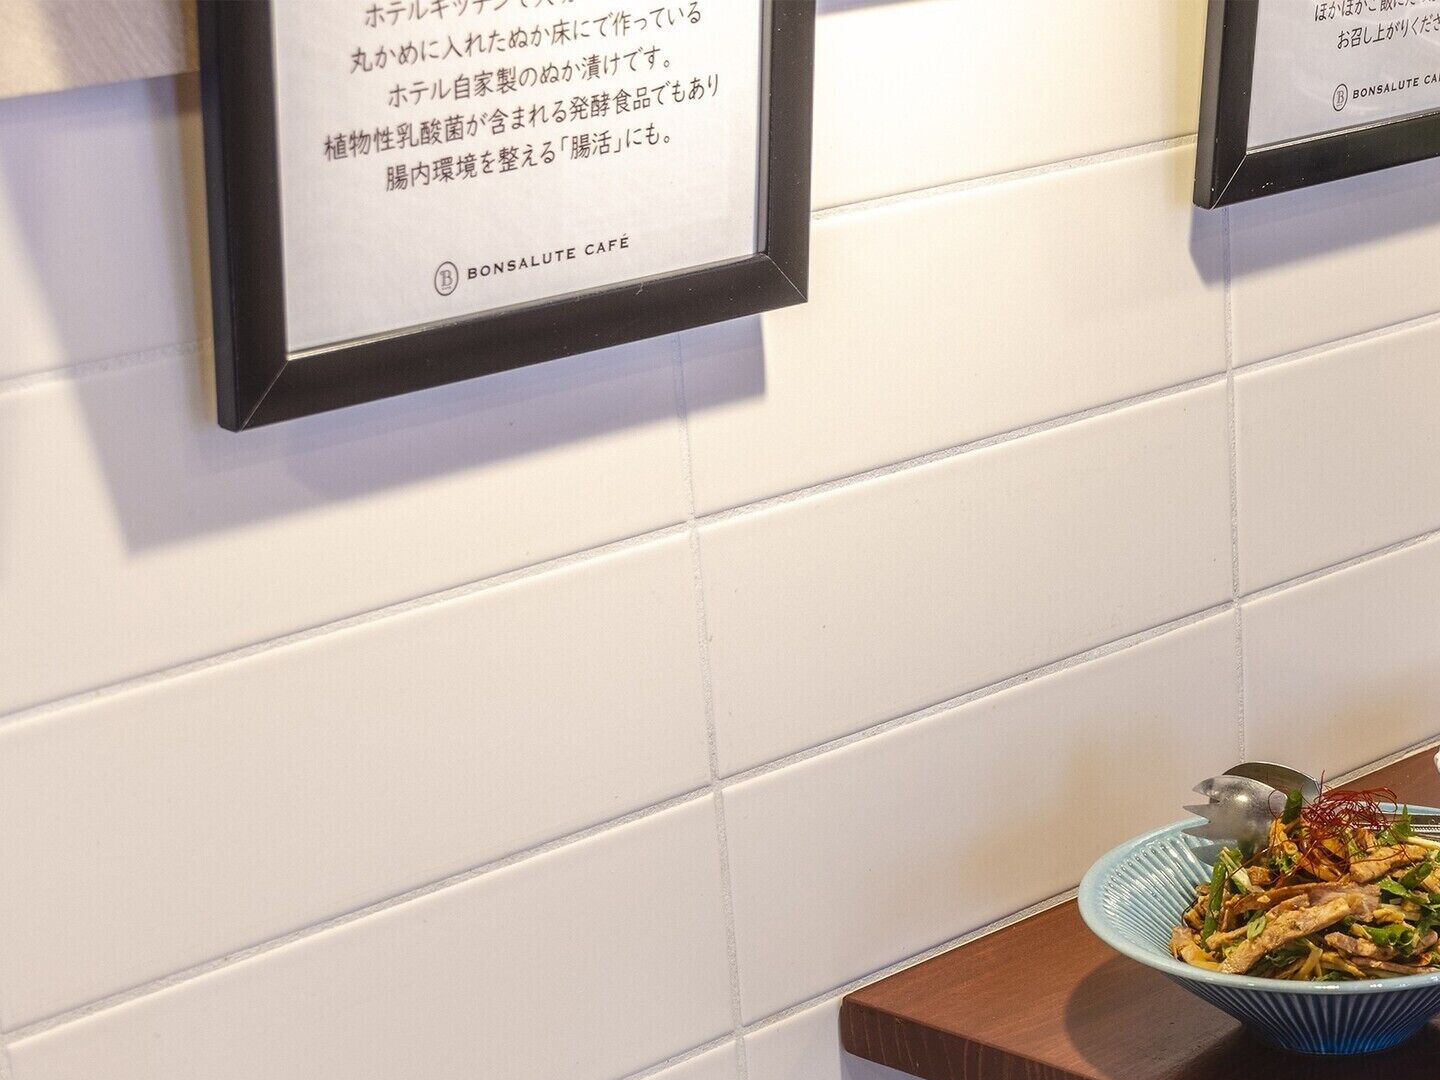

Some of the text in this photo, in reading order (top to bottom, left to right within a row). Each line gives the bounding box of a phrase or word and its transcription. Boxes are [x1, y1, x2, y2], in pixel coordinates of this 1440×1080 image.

[350, 1, 701, 74] 丸かめに入れたぬか床にで作っている
[365, 0, 574, 28] ホテルキッチ
[388, 46, 671, 107] ホテル自家製のぬか漬けです。
[1352, 77, 1420, 99] BONSALUTE
[324, 74, 719, 161] 植物性乳酸菌が含まれる発酵食品でもあり
[386, 123, 671, 192] 腸内環境を整える「腸活」にも。
[467, 247, 576, 280] BONSALUTE
[584, 233, 630, 256] CAFÉ
